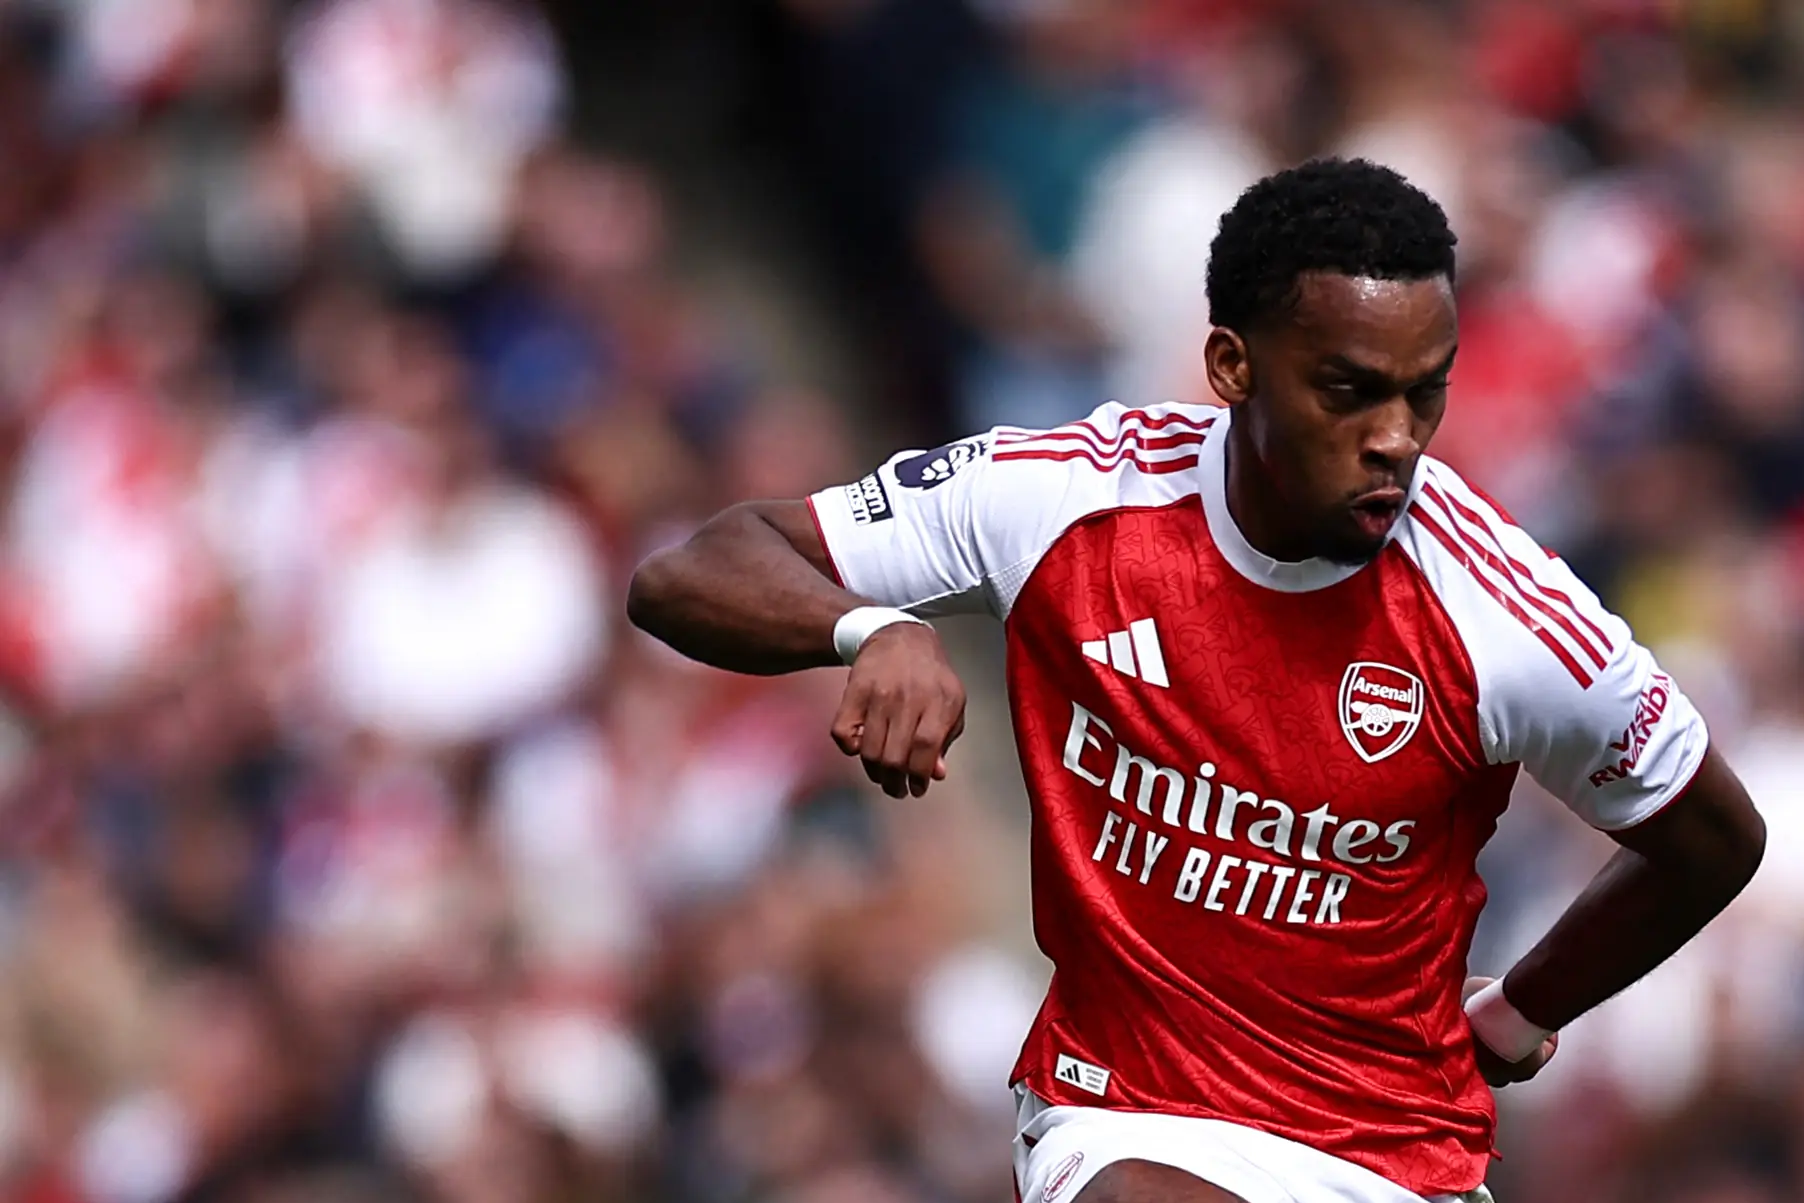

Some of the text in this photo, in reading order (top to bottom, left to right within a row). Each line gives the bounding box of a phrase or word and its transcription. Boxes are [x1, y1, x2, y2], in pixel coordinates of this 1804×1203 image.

[1353, 676, 1412, 704] Arsenal
[1062, 700, 1416, 864] Emirates
[1092, 810, 1352, 924] FLY BETTER
